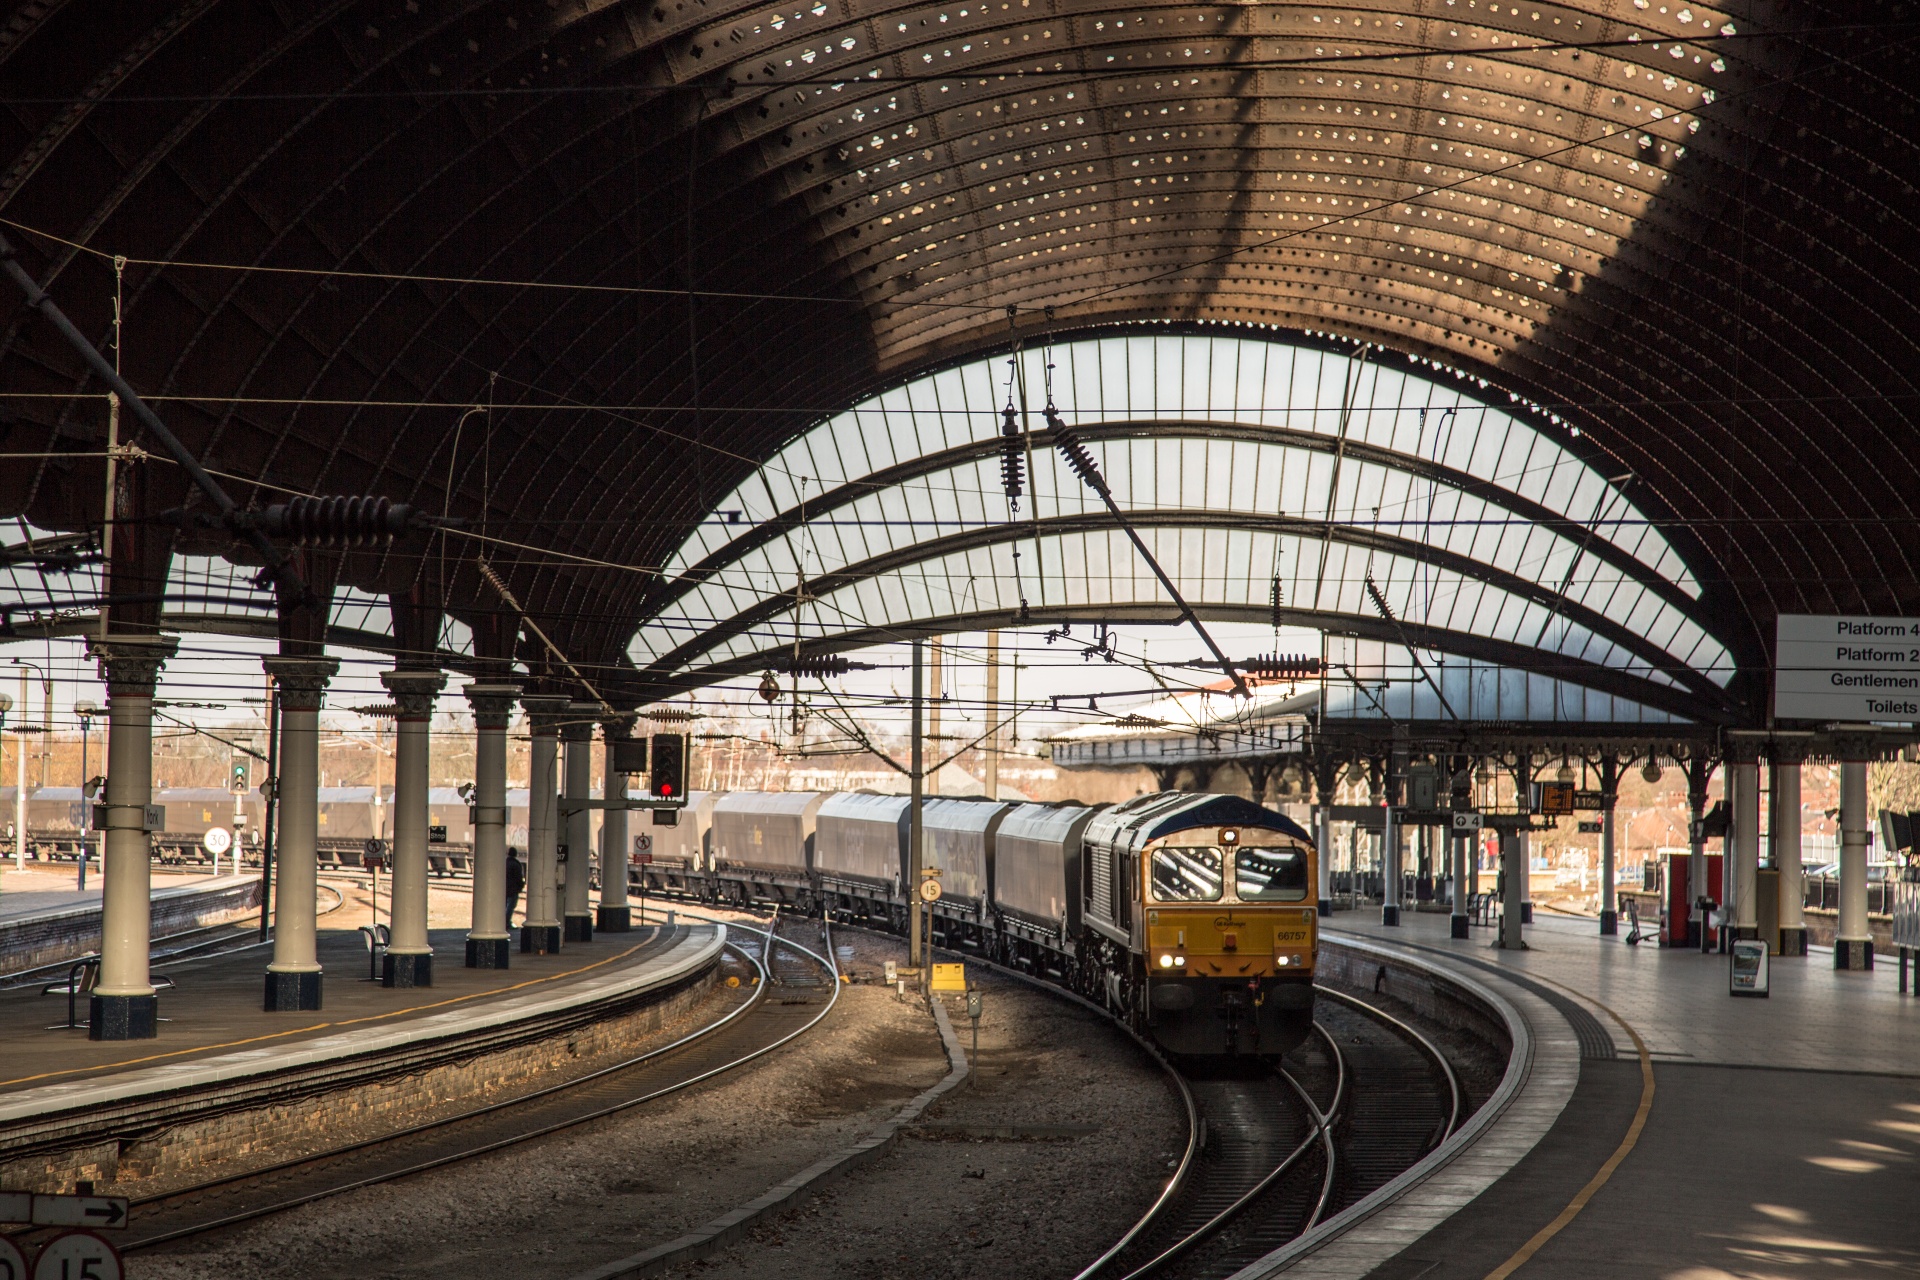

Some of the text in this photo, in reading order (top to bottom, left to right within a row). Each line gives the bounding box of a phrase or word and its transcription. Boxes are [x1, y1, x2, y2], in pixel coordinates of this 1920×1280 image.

[1837, 621, 1920, 636] Platform 4
[1836, 647, 1920, 662] Platform 2
[1831, 673, 1918, 688] Gentlemen
[1866, 699, 1918, 714] Toilets
[146, 808, 158, 825] York
[1471, 816, 1480, 827] 4
[210, 834, 225, 846] 30
[431, 832, 445, 840] Stop
[926, 885, 937, 896] 15
[1277, 931, 1307, 941] 66757
[61, 1257, 103, 1280] 15
